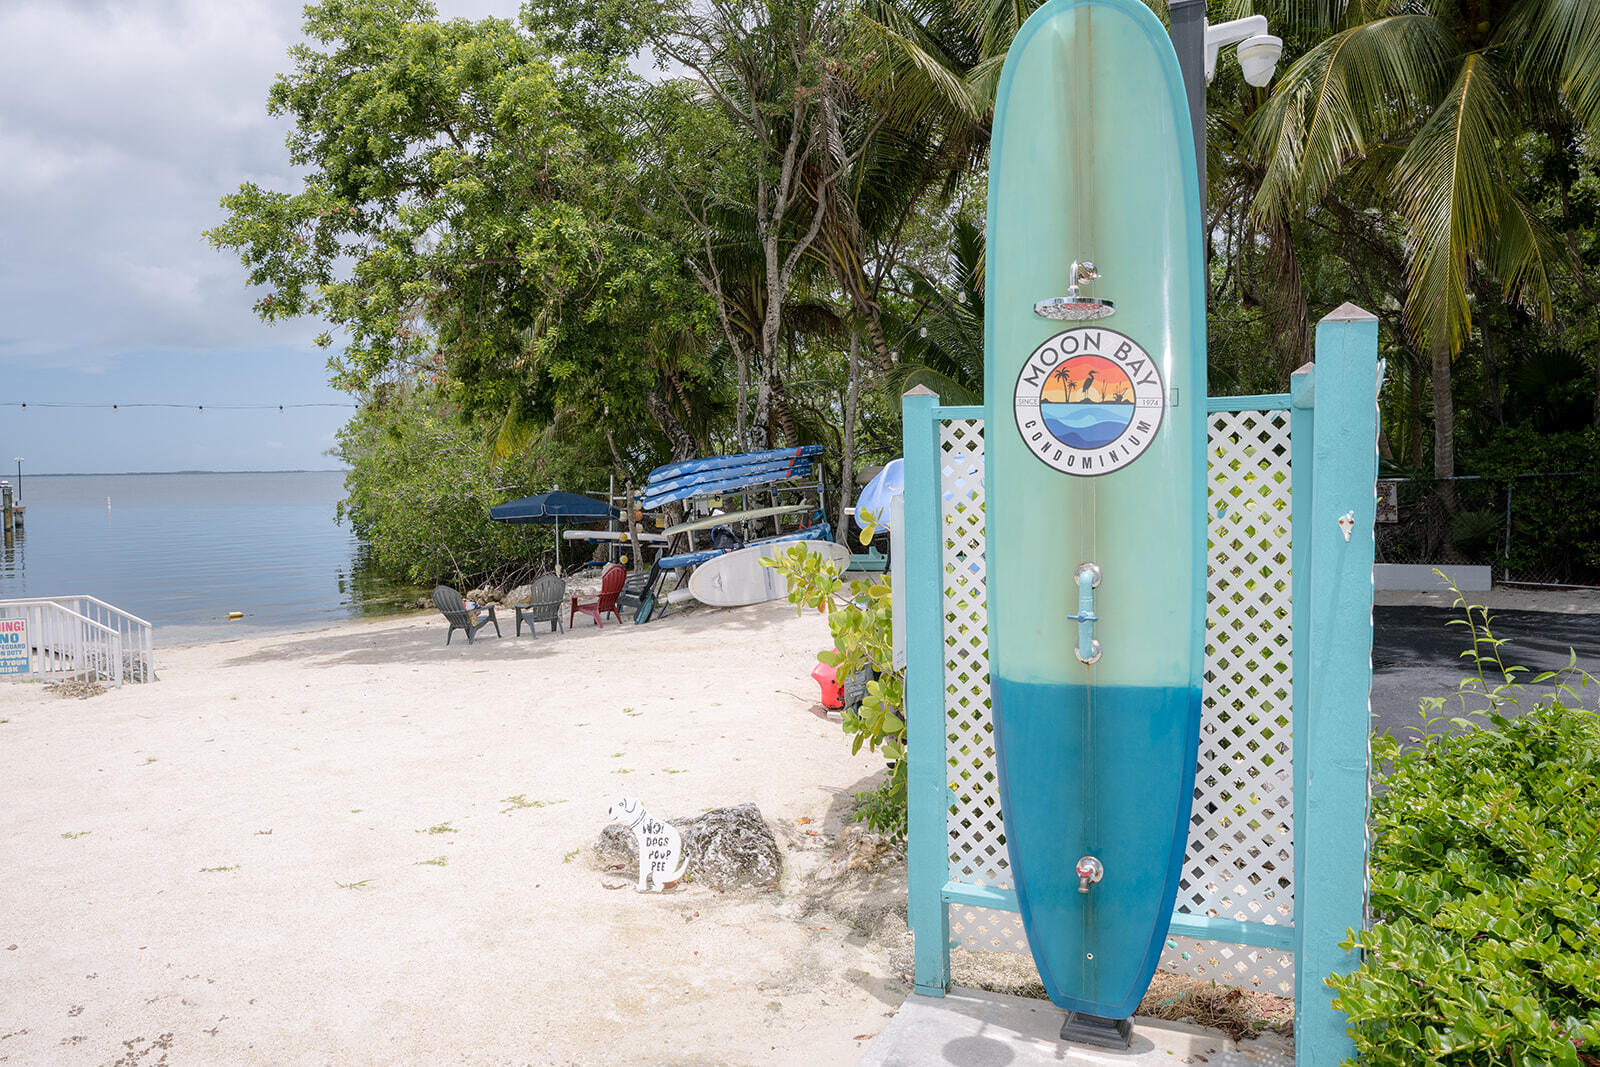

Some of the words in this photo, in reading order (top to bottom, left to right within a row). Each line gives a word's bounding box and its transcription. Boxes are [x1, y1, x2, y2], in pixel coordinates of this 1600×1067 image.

[1023, 332, 1101, 388] MOON
[1113, 341, 1157, 386] BAY
[1025, 420, 1151, 469] CONDOMINIUM
[0, 621, 24, 632] ING!
[646, 837, 669, 847] DOGS
[651, 861, 666, 871] PEE
